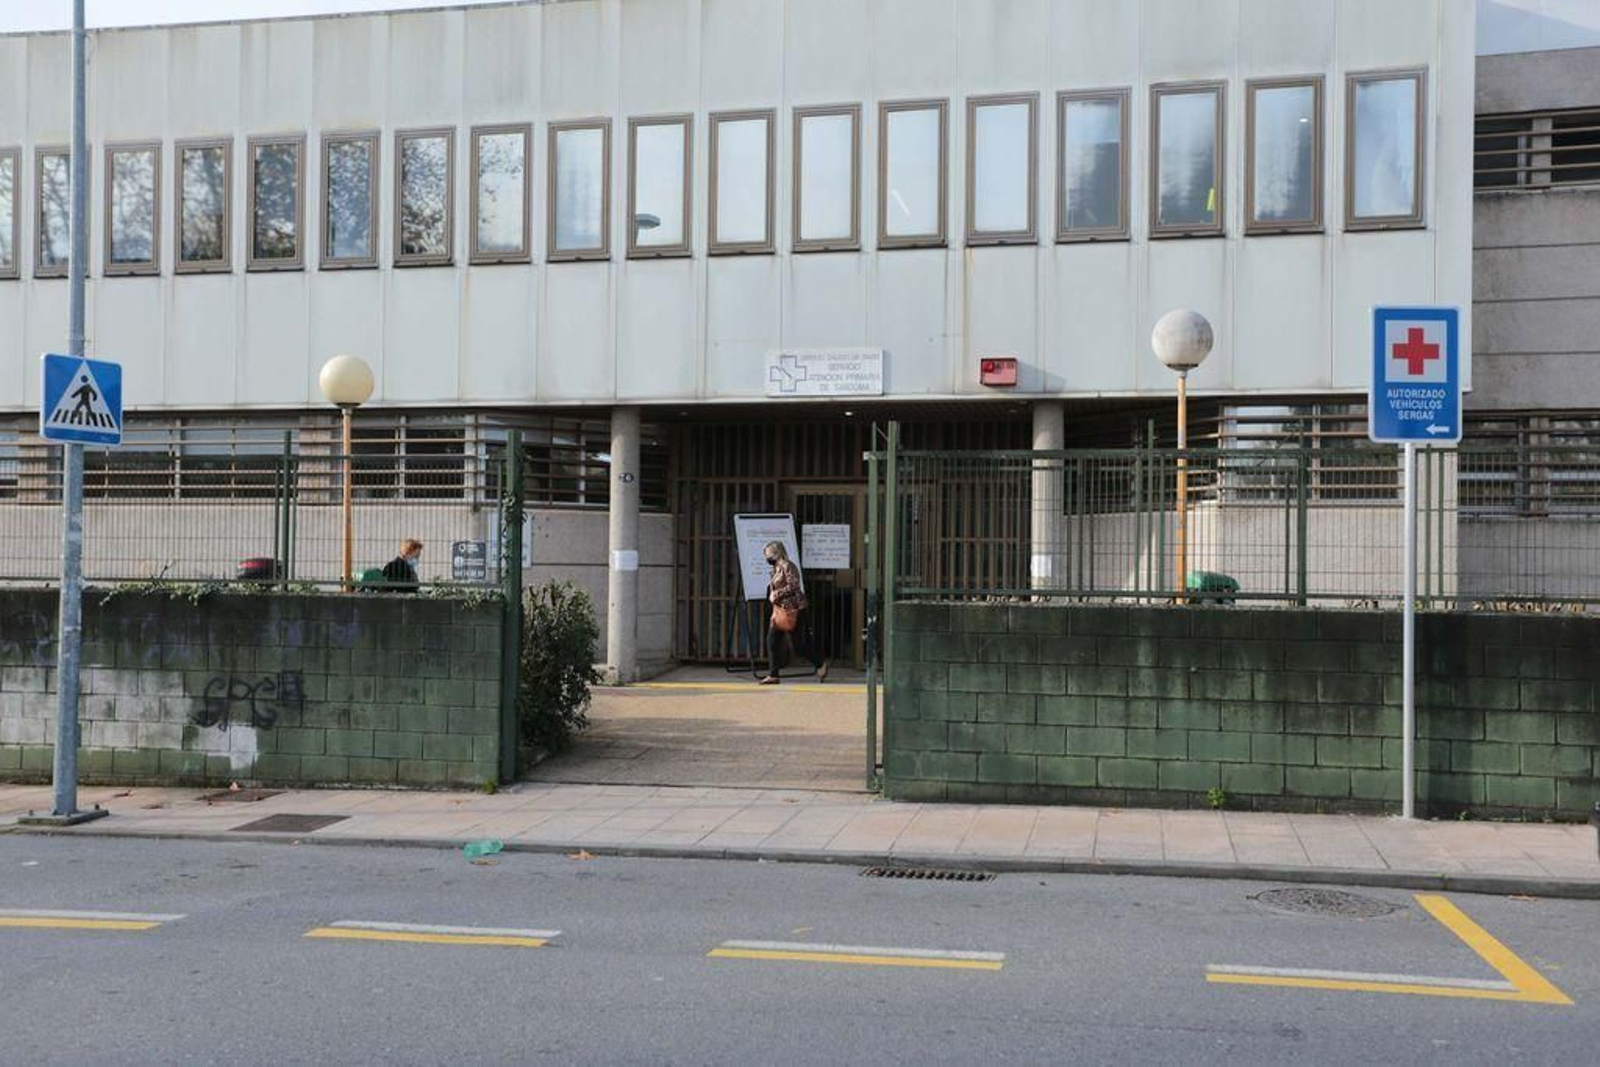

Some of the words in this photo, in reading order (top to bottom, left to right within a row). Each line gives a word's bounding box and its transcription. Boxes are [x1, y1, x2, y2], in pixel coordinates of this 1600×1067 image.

[1386, 388, 1446, 399] AUTORIZADO
[1389, 399, 1443, 409] VEHÍCULOS
[1397, 410, 1435, 421] SERGAS
